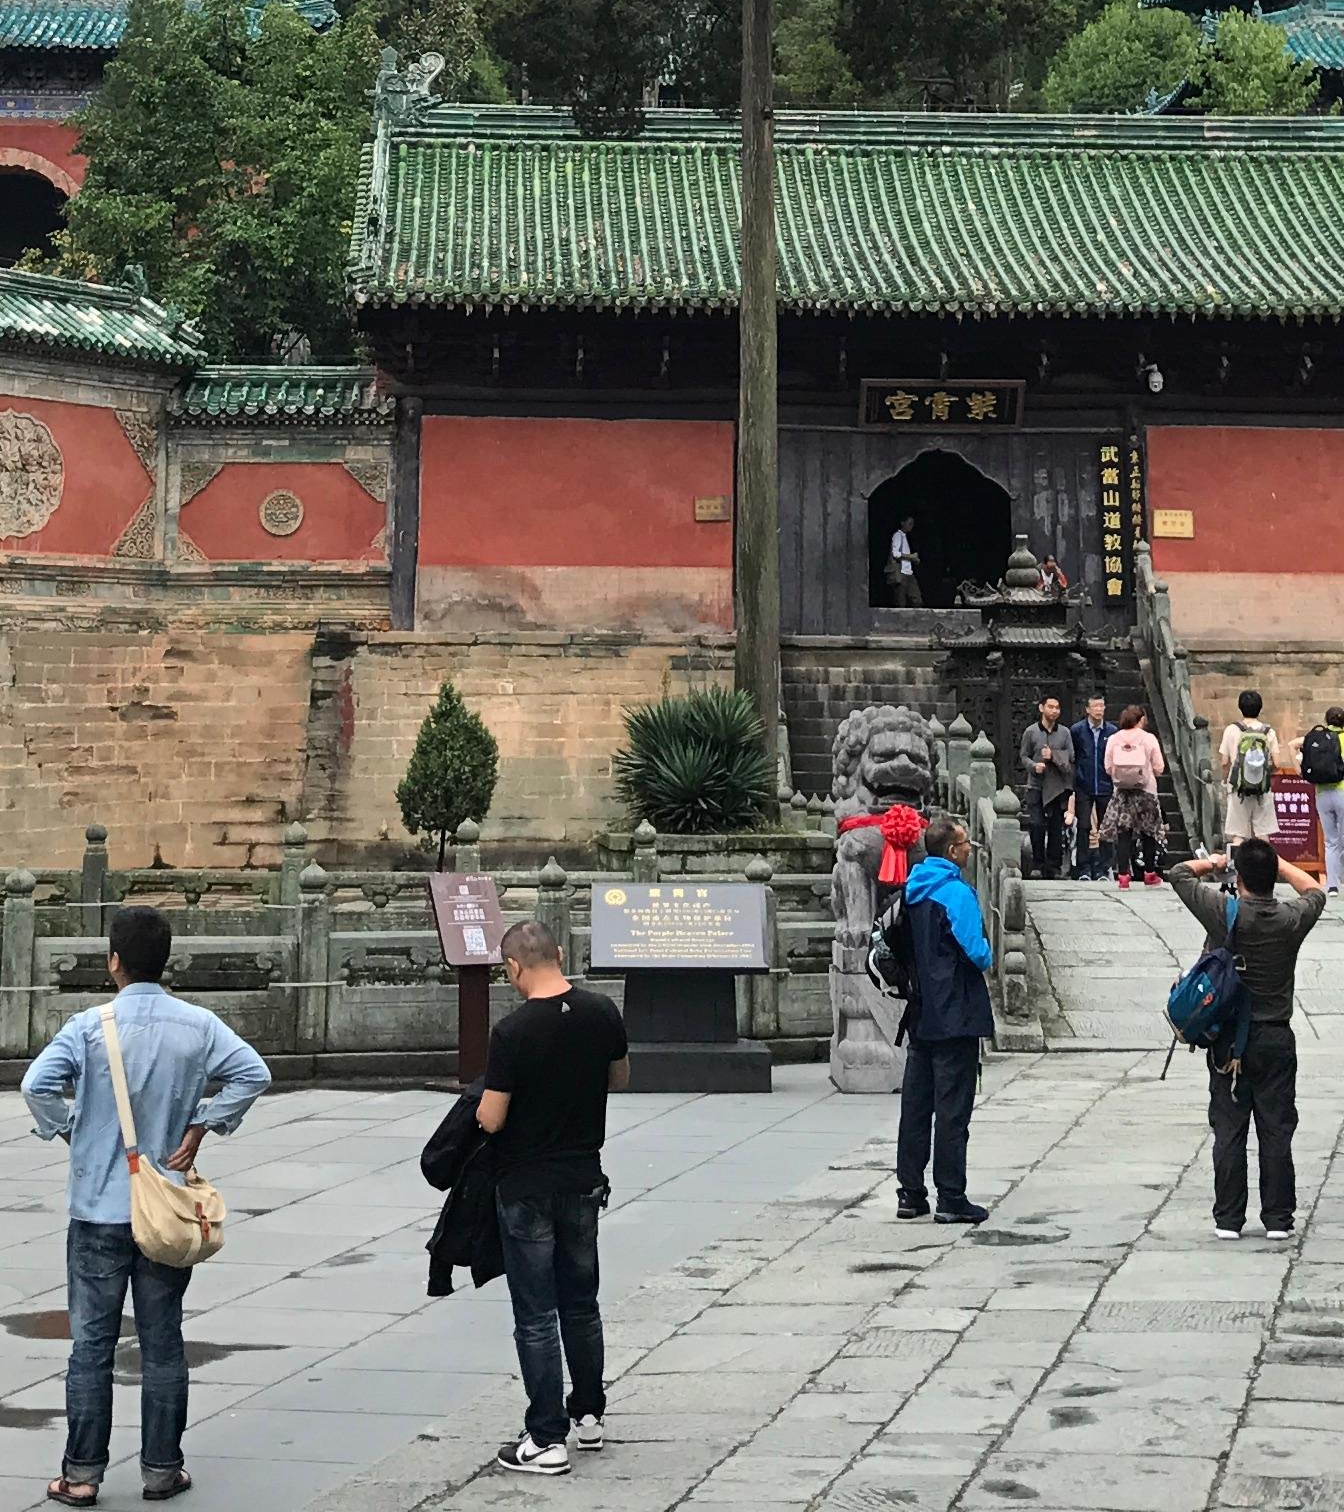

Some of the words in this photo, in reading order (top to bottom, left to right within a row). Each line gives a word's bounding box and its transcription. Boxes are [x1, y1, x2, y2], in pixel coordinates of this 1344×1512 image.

[1100, 445, 1123, 596] 武當山道教協會
